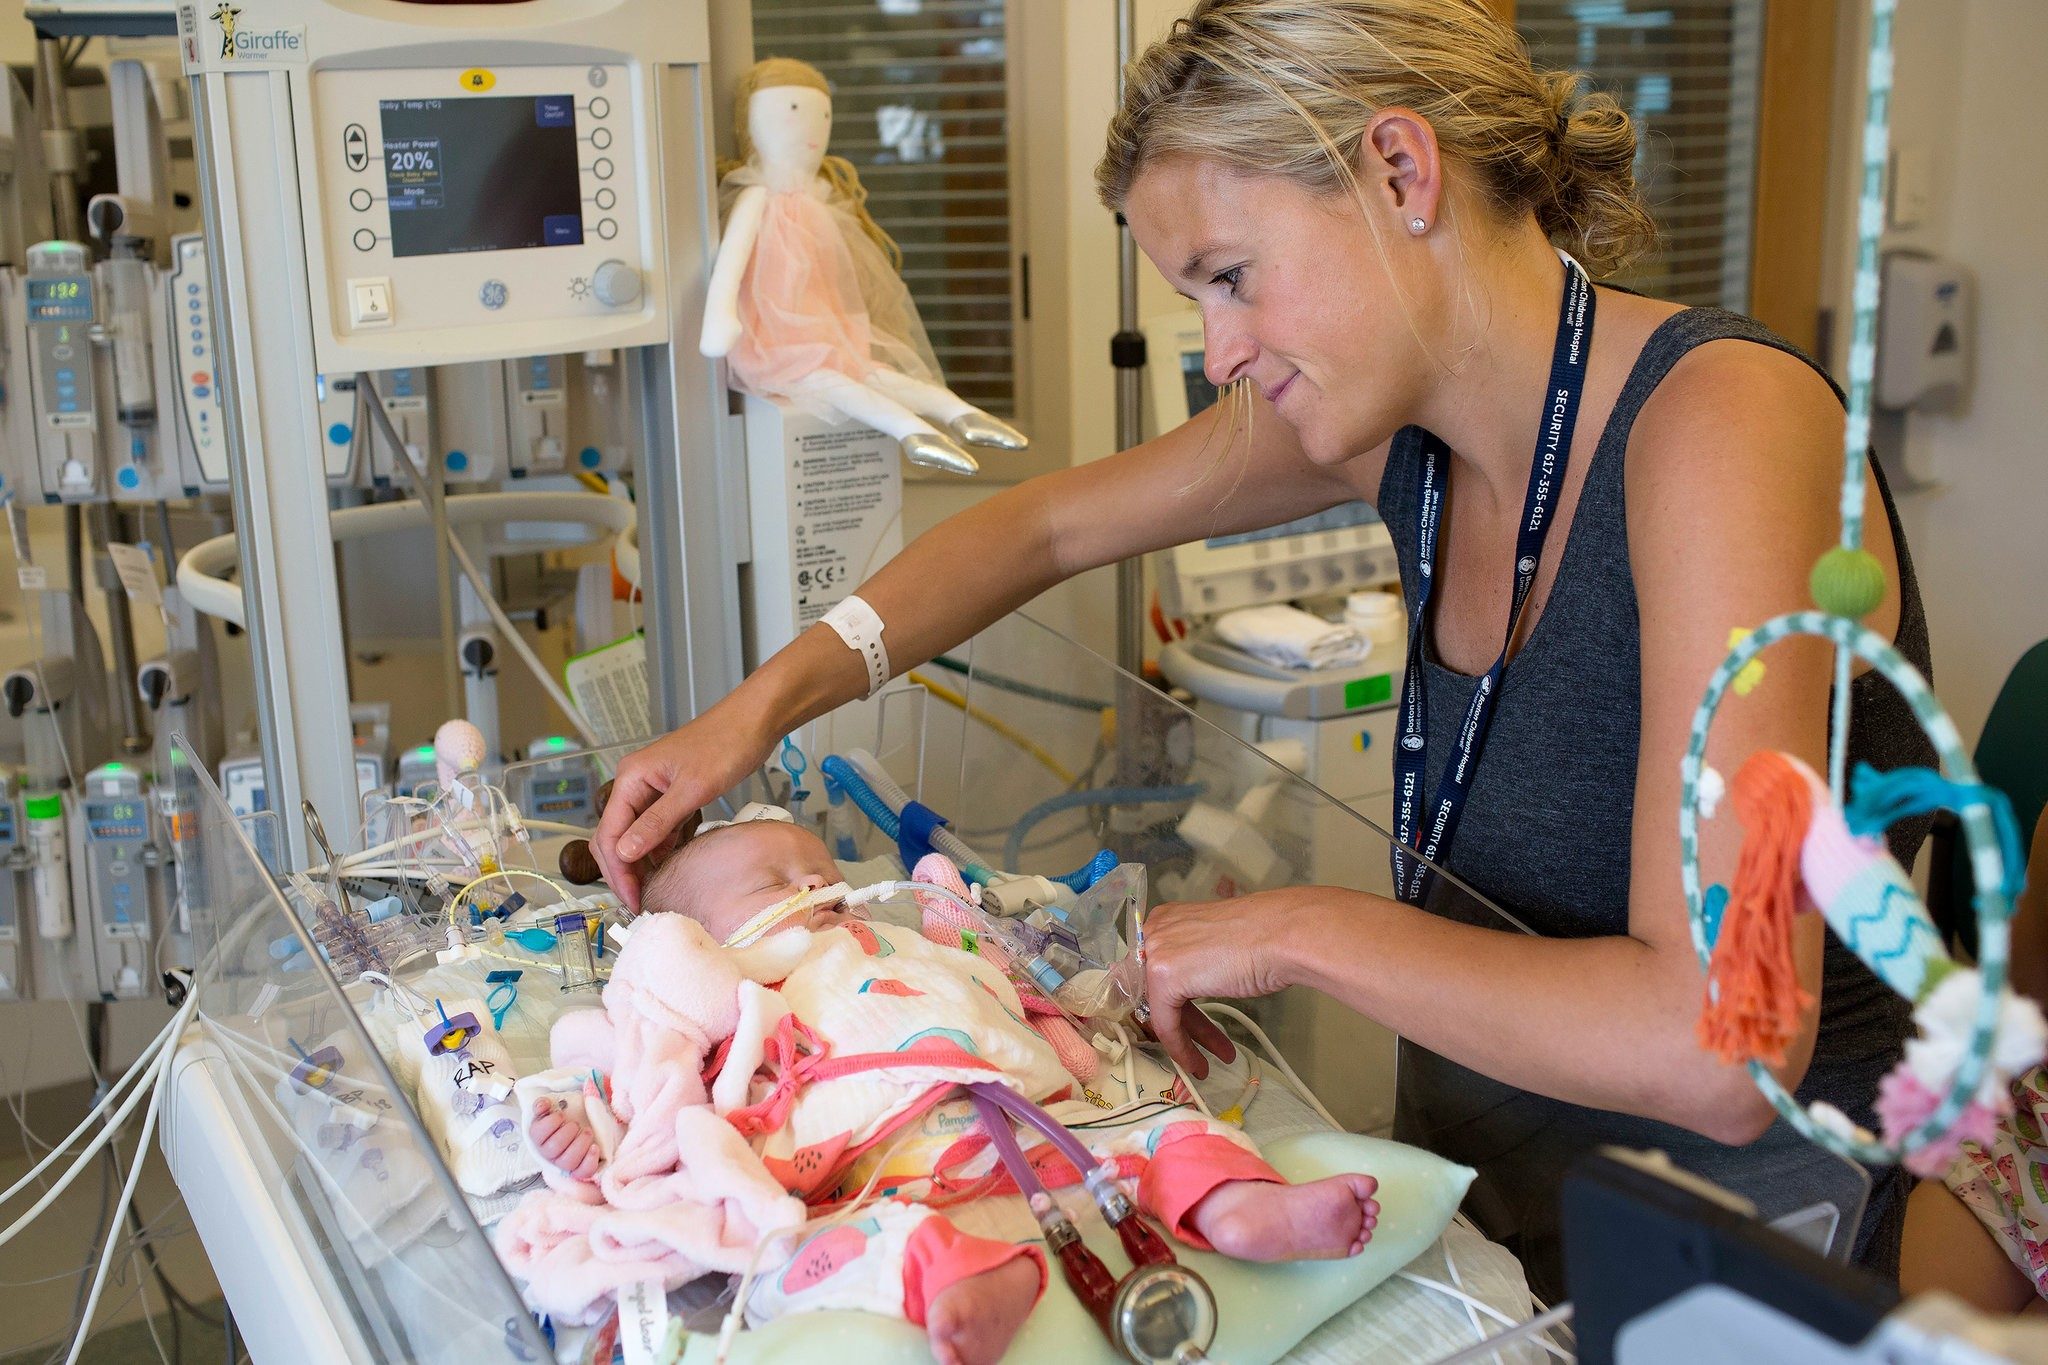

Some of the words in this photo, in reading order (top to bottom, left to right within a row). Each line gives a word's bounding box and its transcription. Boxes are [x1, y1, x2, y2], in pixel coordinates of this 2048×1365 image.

[235, 30, 299, 50] Giraffe
[237, 51, 268, 59] Warmer
[412, 141, 439, 149] Power
[391, 151, 433, 171] 20%
[403, 188, 425, 196] Mode
[1570, 277, 1579, 291] every
[1569, 292, 1577, 306] child
[1575, 292, 1589, 327] Children's
[1569, 328, 1584, 364] Hospital
[1547, 389, 1568, 451] SECURITY
[1424, 453, 1435, 488] Hospital
[1528, 453, 1555, 532] 617-355-6121
[1421, 488, 1432, 528] Children's
[1406, 705, 1416, 733] Boston
[1473, 695, 1485, 720] Boston
[1464, 720, 1478, 754] Children's
[1455, 753, 1470, 784] Hospital
[1400, 771, 1415, 844] 617-355-6121
[1430, 798, 1452, 845] SECURITY
[454, 1060, 494, 1089] RAP
[938, 1112, 980, 1129] Pamper
